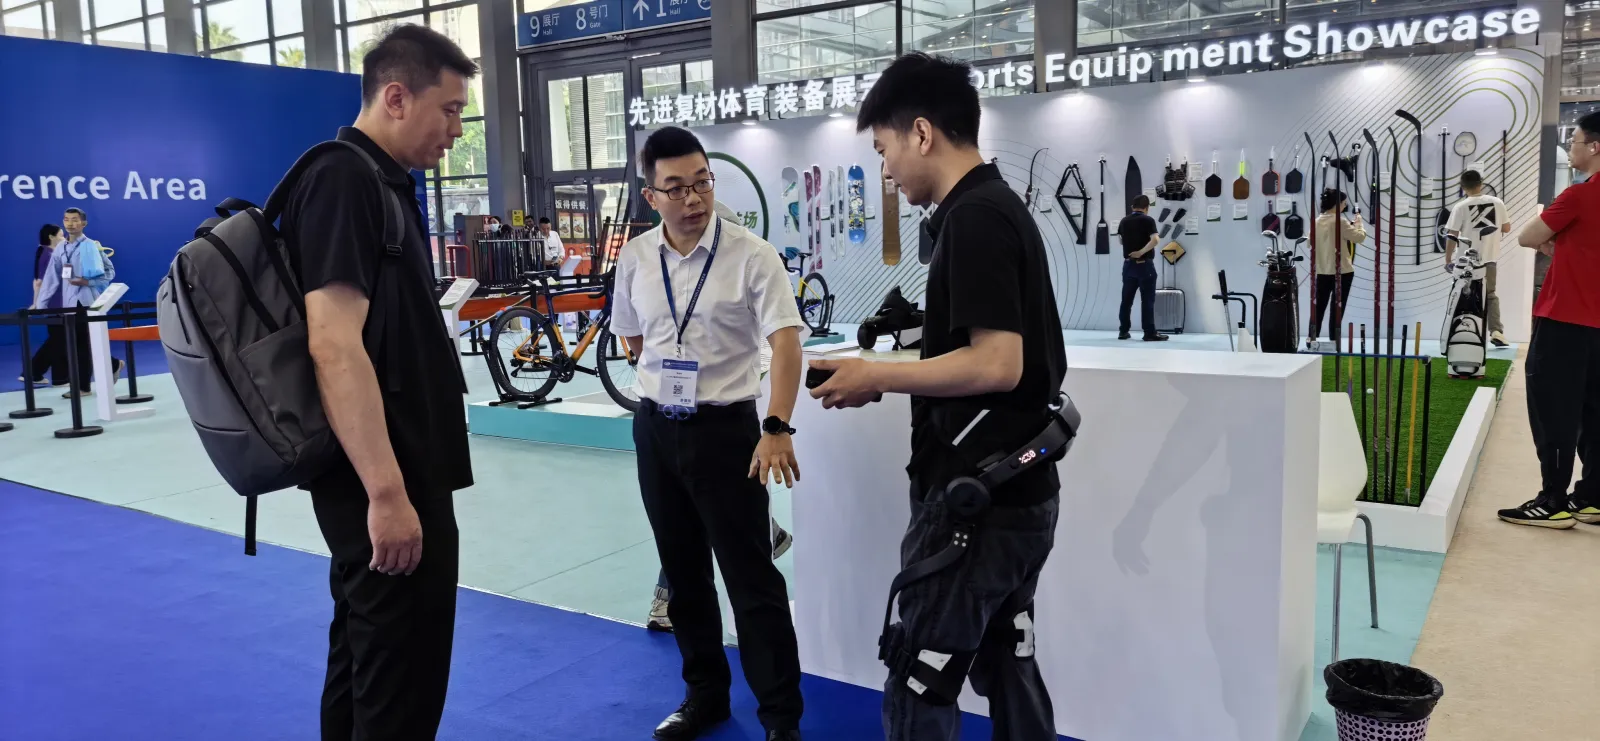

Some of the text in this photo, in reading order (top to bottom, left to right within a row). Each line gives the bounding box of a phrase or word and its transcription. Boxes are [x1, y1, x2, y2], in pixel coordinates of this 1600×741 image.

[529, 12, 560, 38] 9 展厅
[576, 4, 608, 31] 8 号门
[589, 21, 602, 29] Gate
[669, 8, 681, 16] Hall
[542, 28, 553, 36] Hall
[968, 61, 1034, 90] orts
[1283, 7, 1541, 58] Showcase
[123, 171, 207, 201] Area
